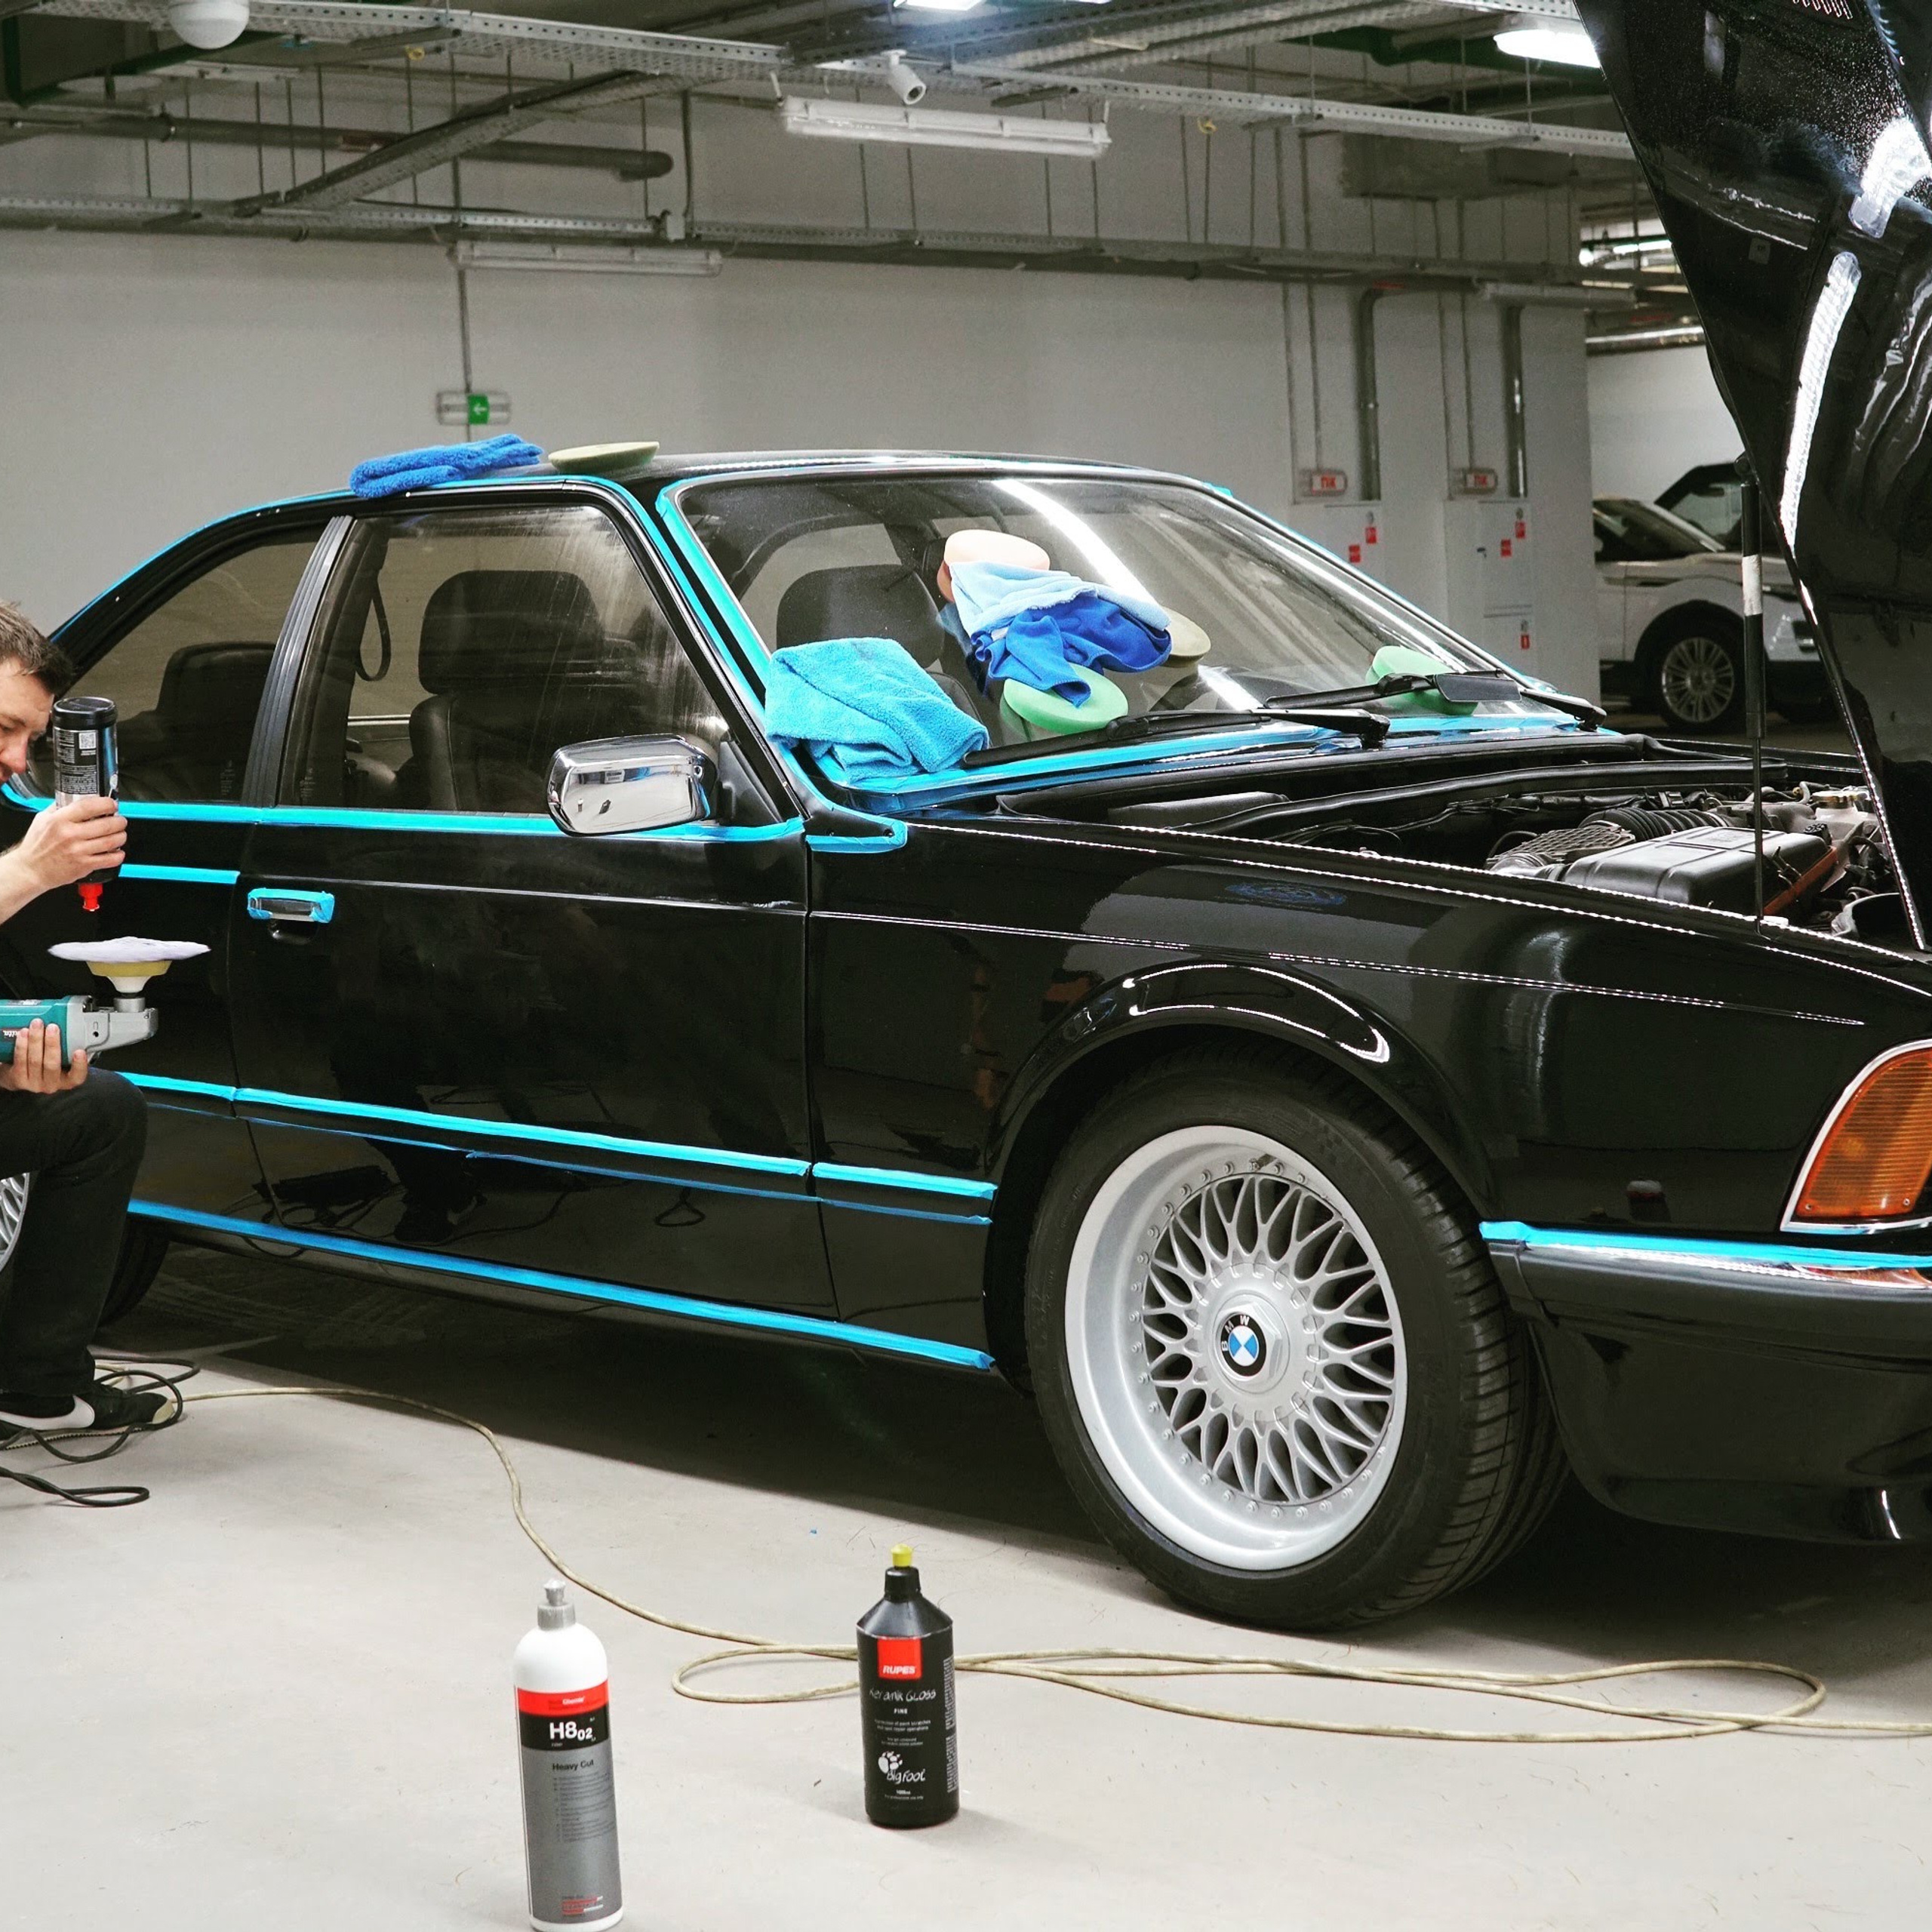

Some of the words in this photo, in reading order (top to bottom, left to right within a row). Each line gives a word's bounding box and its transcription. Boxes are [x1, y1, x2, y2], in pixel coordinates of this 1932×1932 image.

[1221, 1315, 1250, 1352] BMW
[882, 1665, 915, 1675] RUPES
[552, 1762, 579, 1771] Heavy
[580, 1759, 595, 1768] Cut
